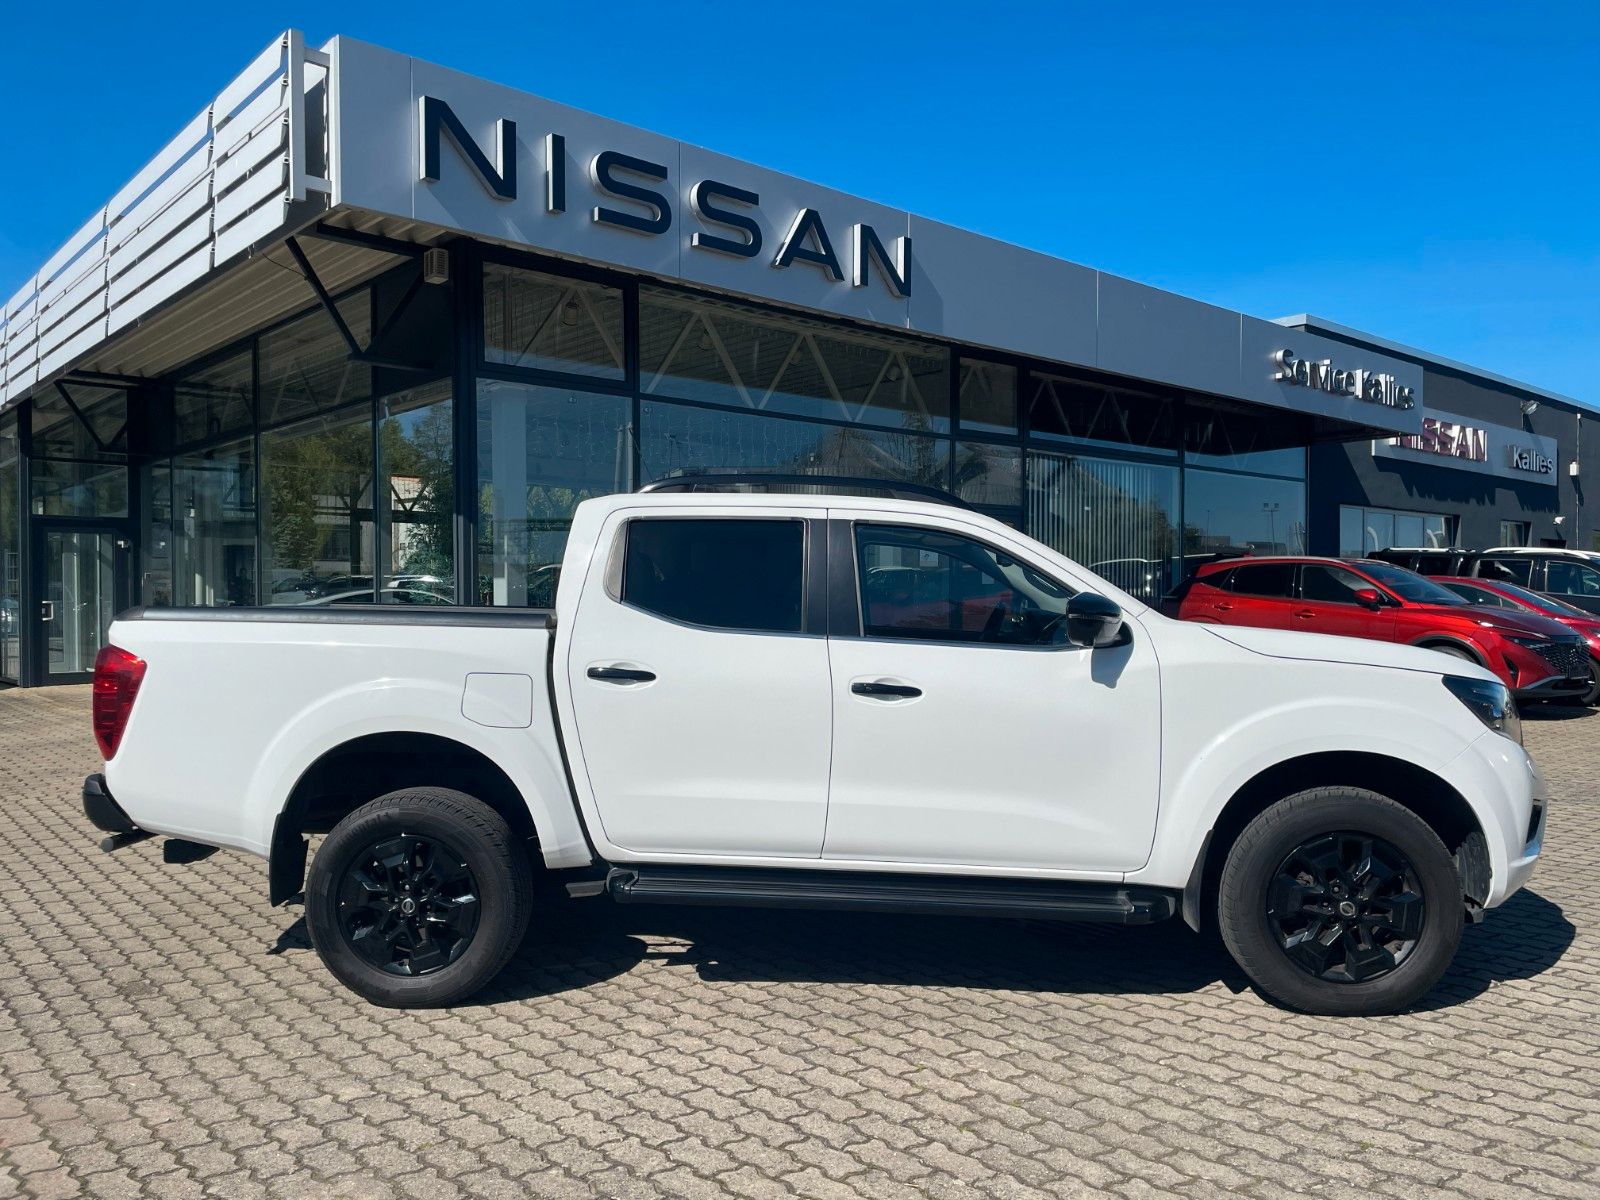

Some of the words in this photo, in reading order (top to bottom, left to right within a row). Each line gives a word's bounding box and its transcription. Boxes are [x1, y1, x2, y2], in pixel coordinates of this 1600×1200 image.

[418, 95, 912, 298] NISSAN
[1275, 348, 1355, 396] Service
[1355, 368, 1415, 410] Kallies
[1510, 444, 1554, 475] Kallies
